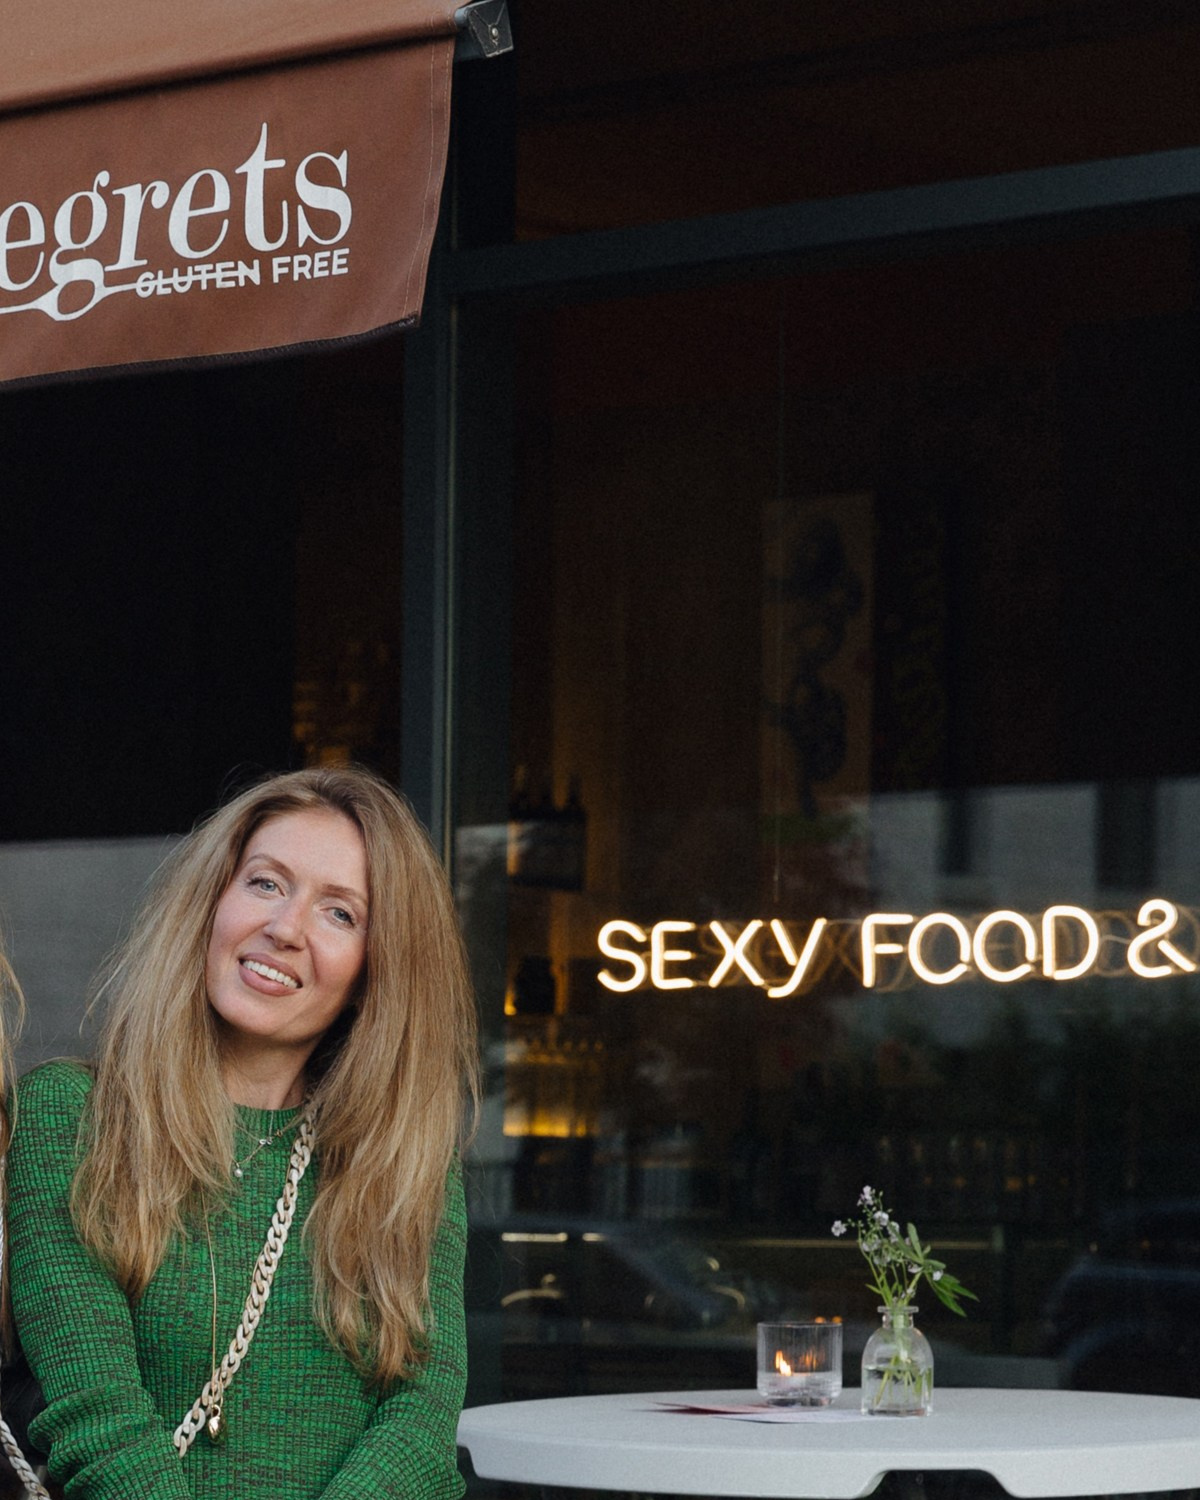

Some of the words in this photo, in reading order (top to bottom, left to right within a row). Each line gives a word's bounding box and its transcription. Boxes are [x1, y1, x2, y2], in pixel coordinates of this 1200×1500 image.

[135, 257, 261, 299] GLUTEN
[272, 247, 351, 284] FREE
[597, 917, 827, 999] SEXY
[860, 904, 1100, 989] FOOD
[1126, 898, 1197, 978] &
